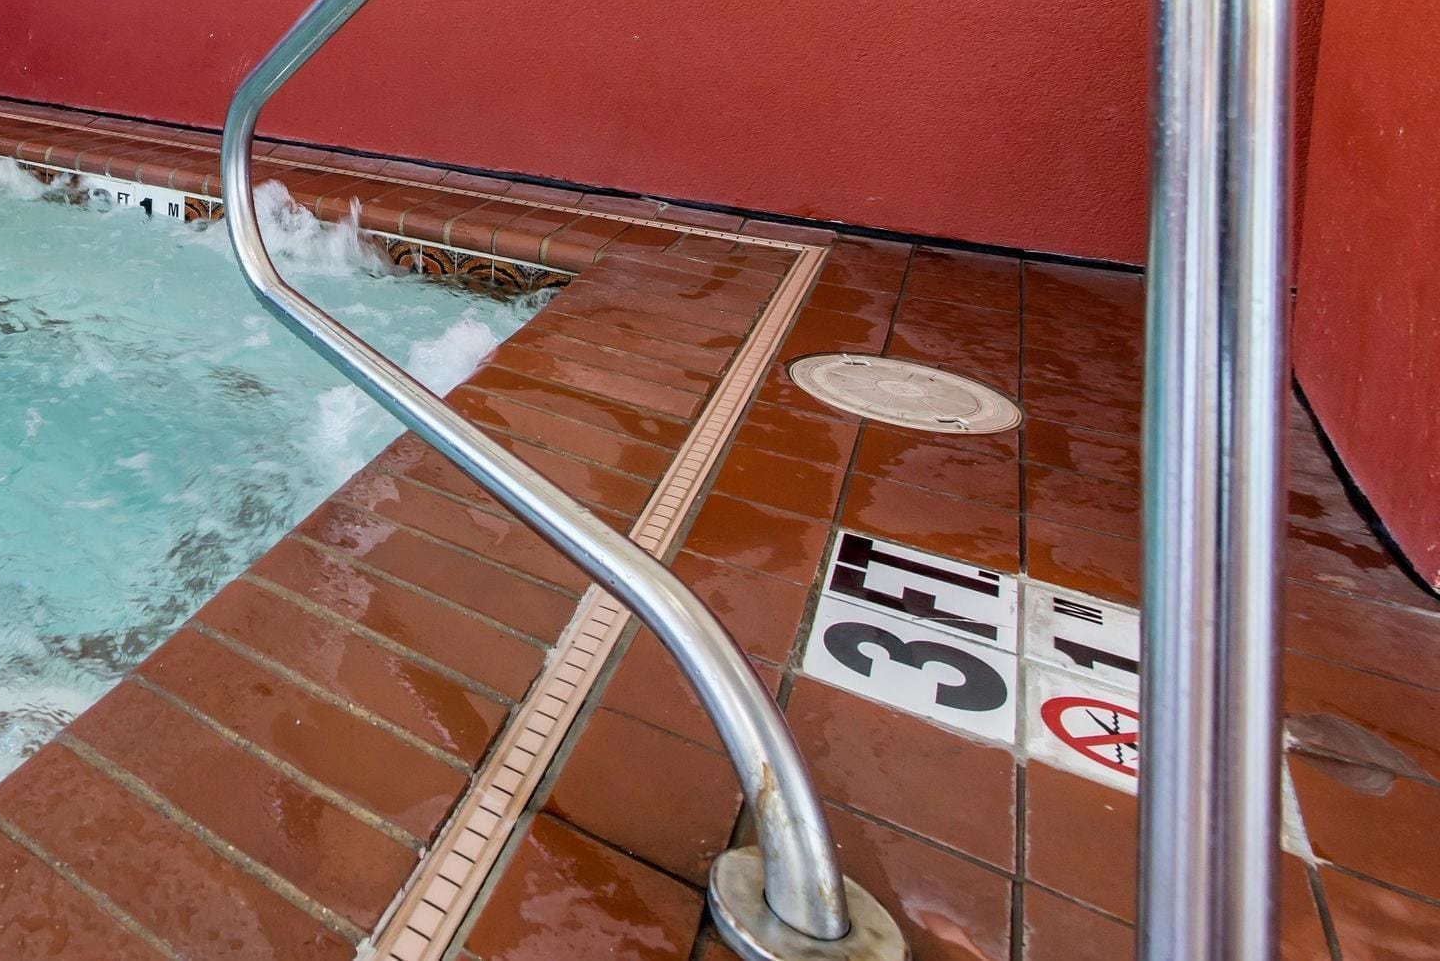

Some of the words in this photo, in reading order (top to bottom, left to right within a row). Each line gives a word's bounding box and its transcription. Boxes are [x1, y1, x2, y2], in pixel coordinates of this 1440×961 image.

[117, 192, 130, 204] FT
[140, 197, 152, 217] 1
[168, 202, 179, 217] M
[1053, 597, 1103, 625] M
[823, 621, 1008, 712] 3
[1054, 636, 1140, 674] 1
